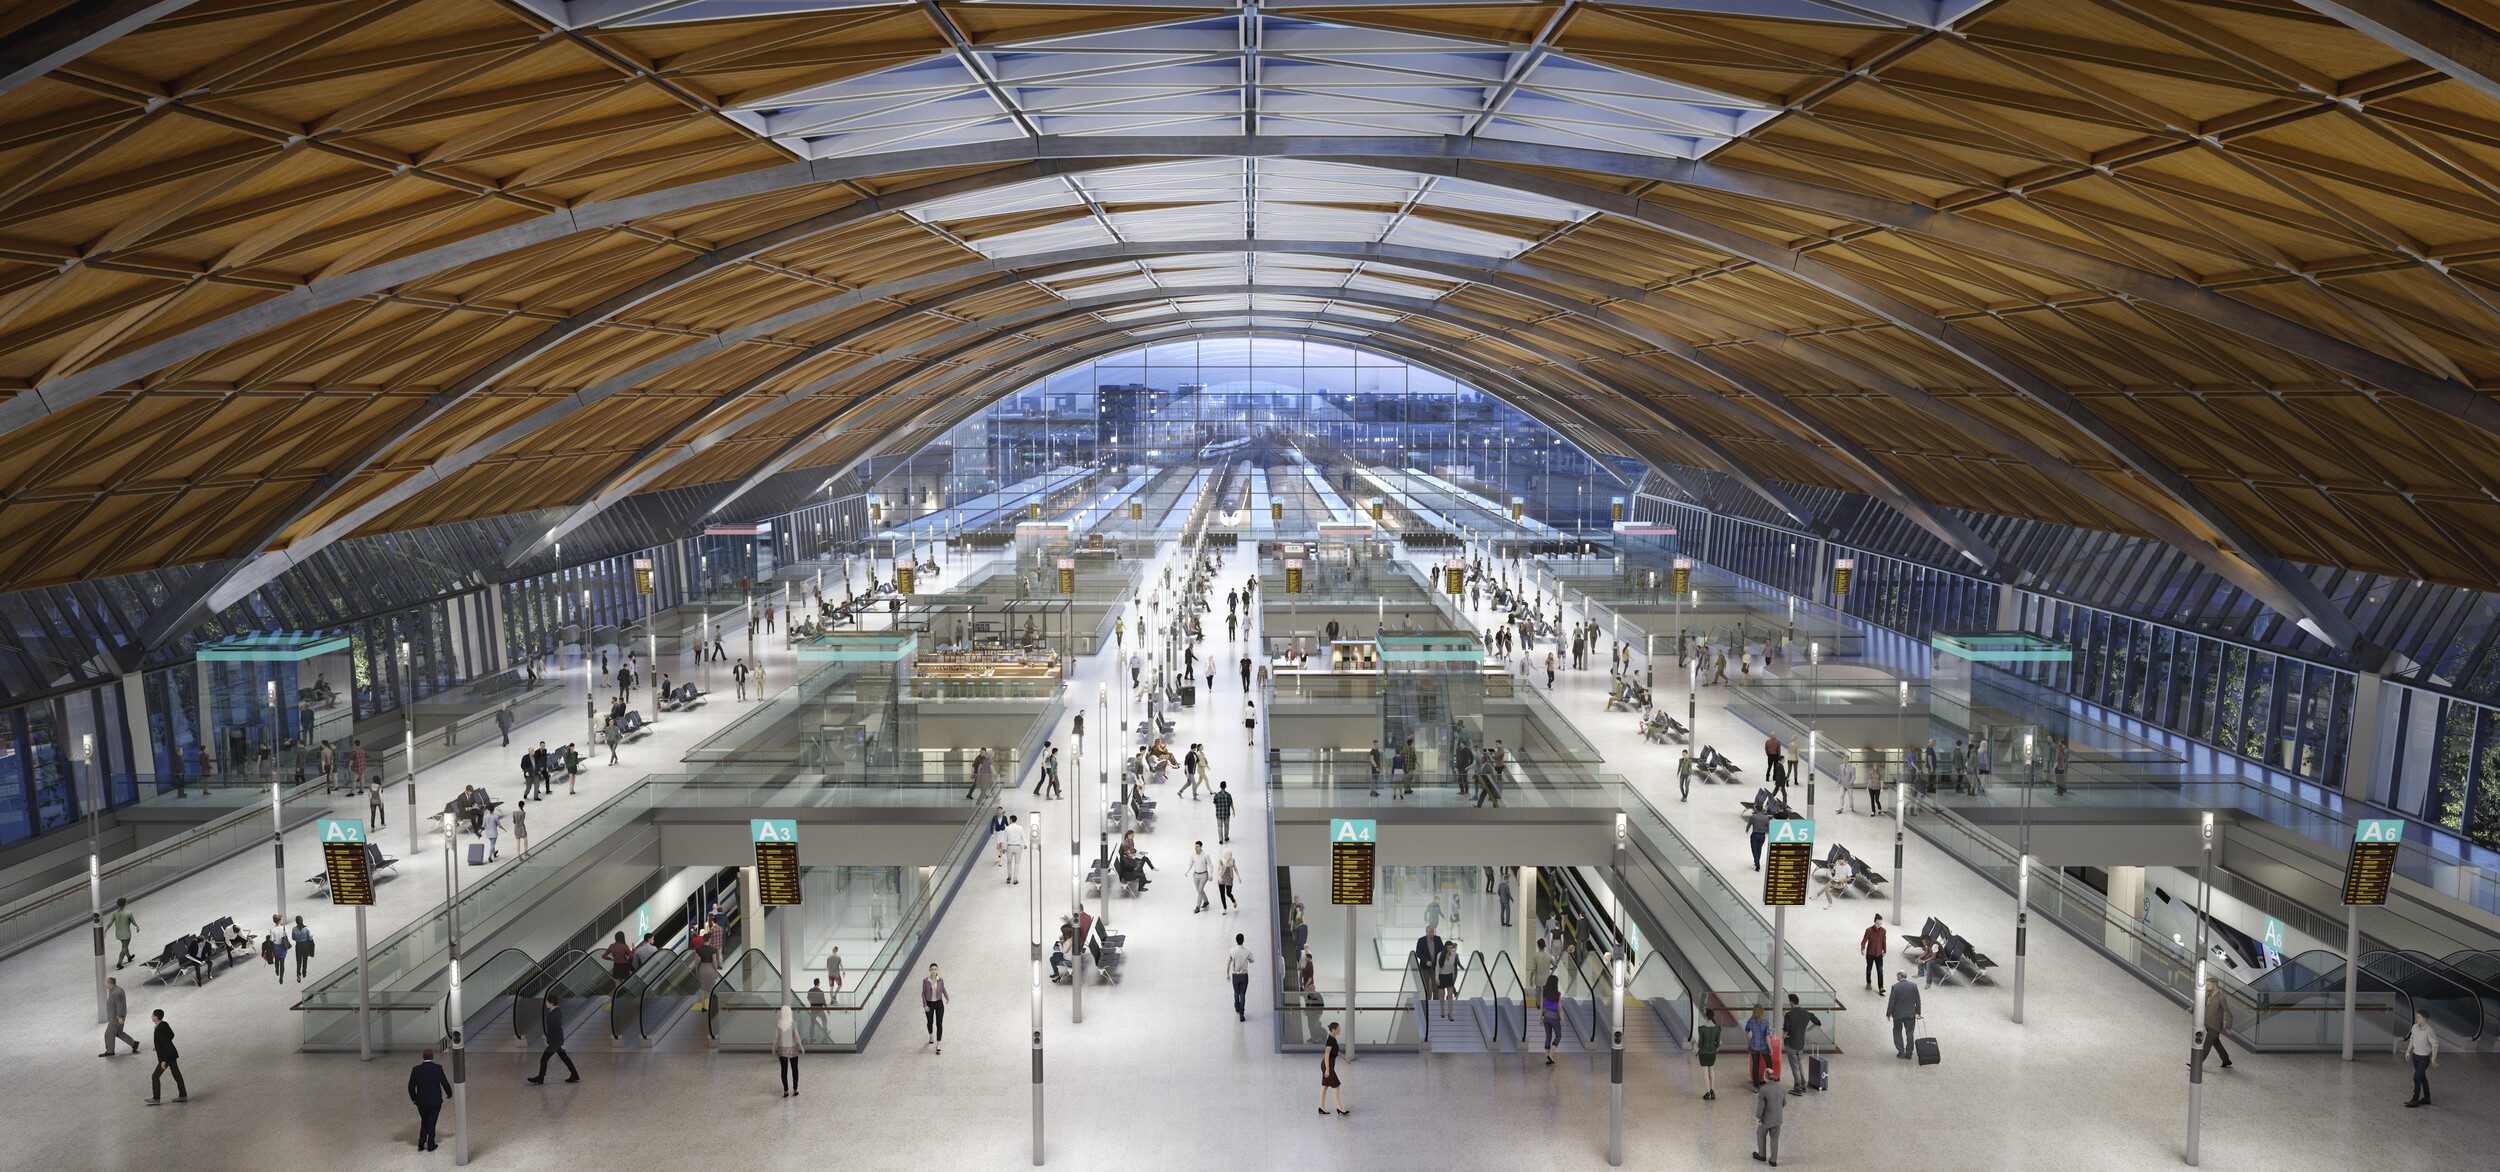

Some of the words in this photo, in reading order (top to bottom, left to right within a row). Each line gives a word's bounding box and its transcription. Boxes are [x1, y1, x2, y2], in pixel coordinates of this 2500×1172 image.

[637, 559, 648, 568] B1
[327, 821, 358, 841] A2
[759, 821, 791, 841] A3
[1337, 821, 1370, 841] A4
[1776, 821, 1808, 841] A5
[2361, 821, 2396, 841] A6
[2265, 920, 2282, 949] A6
